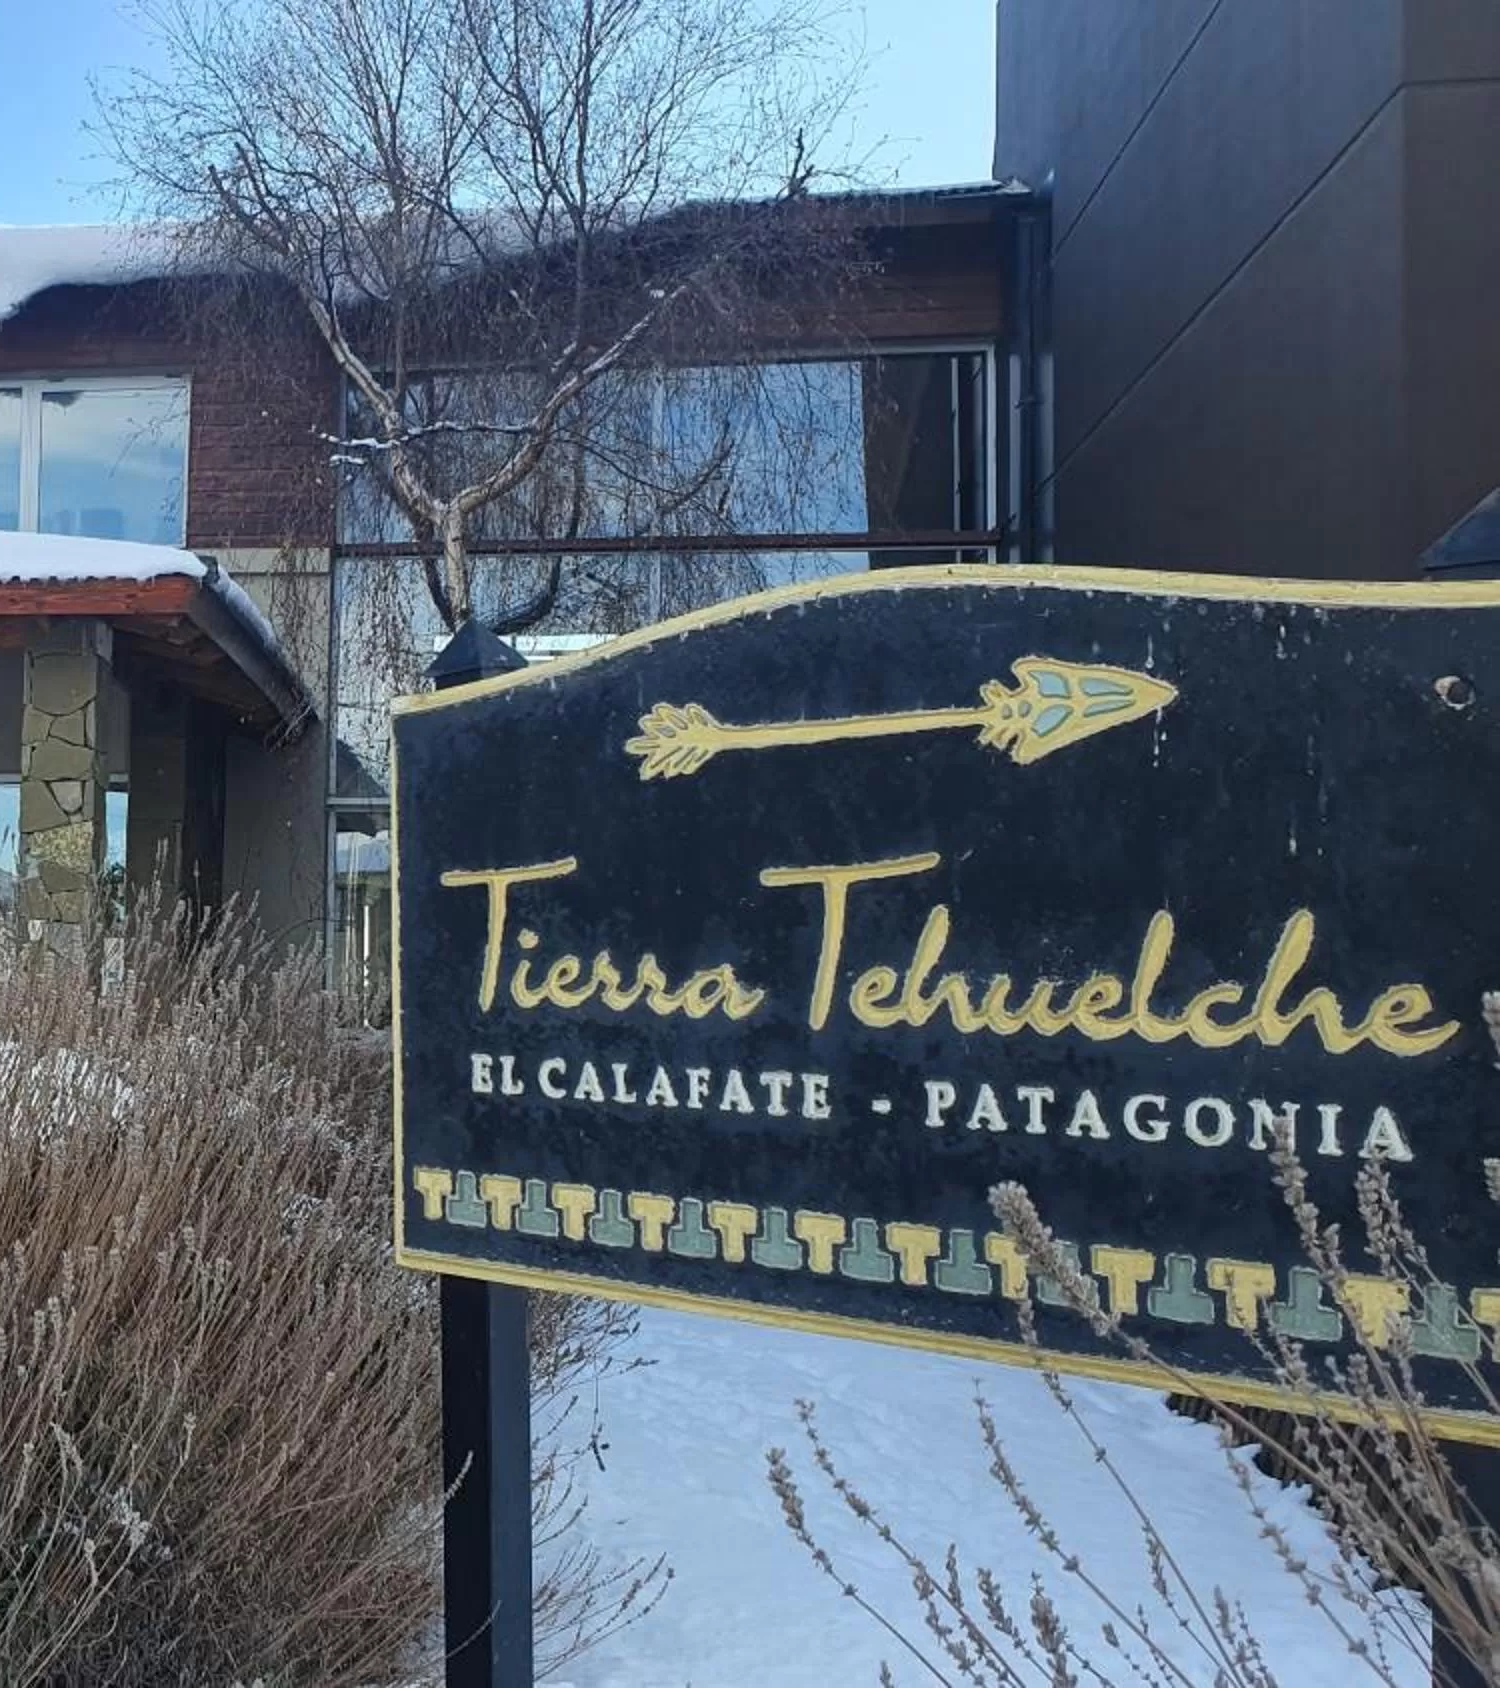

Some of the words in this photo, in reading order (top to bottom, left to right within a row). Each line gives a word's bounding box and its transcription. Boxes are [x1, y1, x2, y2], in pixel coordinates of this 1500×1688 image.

[440, 855, 766, 1020] Tierra
[759, 851, 1461, 1057] Tehuelche
[470, 1052, 524, 1096] EL
[537, 1056, 832, 1119] CALAFATE
[924, 1080, 1415, 1162] PATAGONIA
